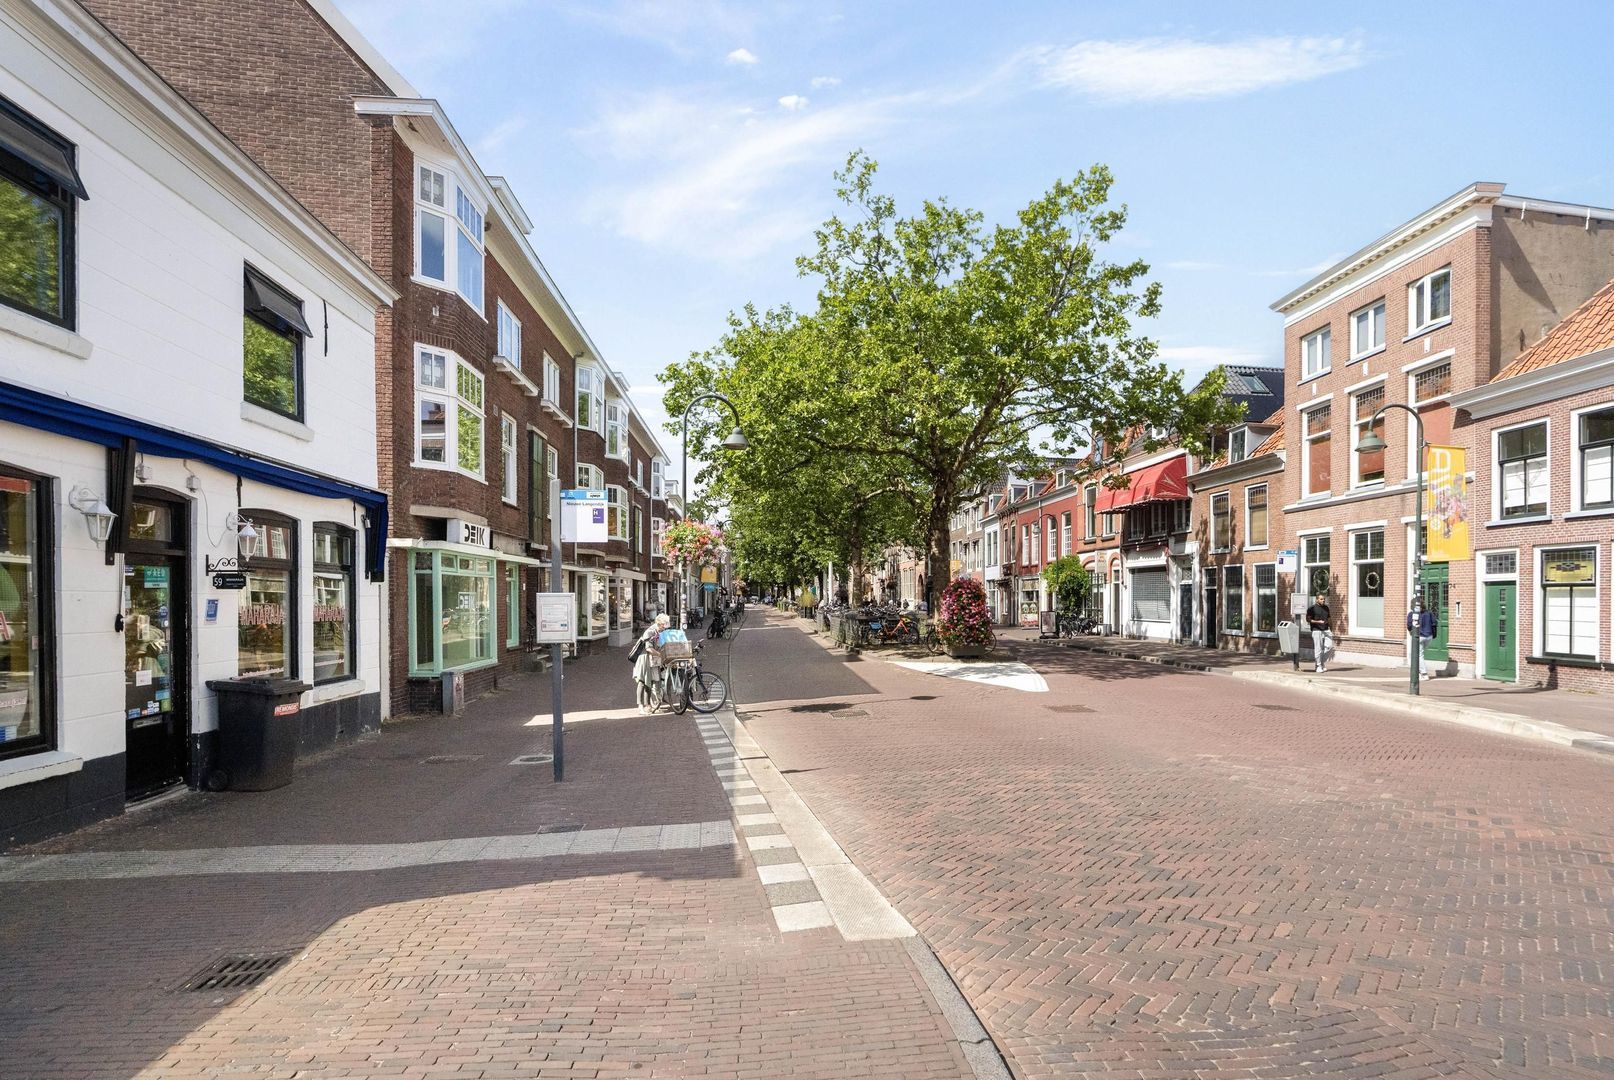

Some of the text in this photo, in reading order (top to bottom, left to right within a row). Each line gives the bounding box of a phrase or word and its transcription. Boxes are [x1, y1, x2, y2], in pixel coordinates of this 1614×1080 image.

[464, 523, 486, 546] DEIK
[214, 577, 223, 587] 59
[239, 603, 285, 626] MAHARAJA
